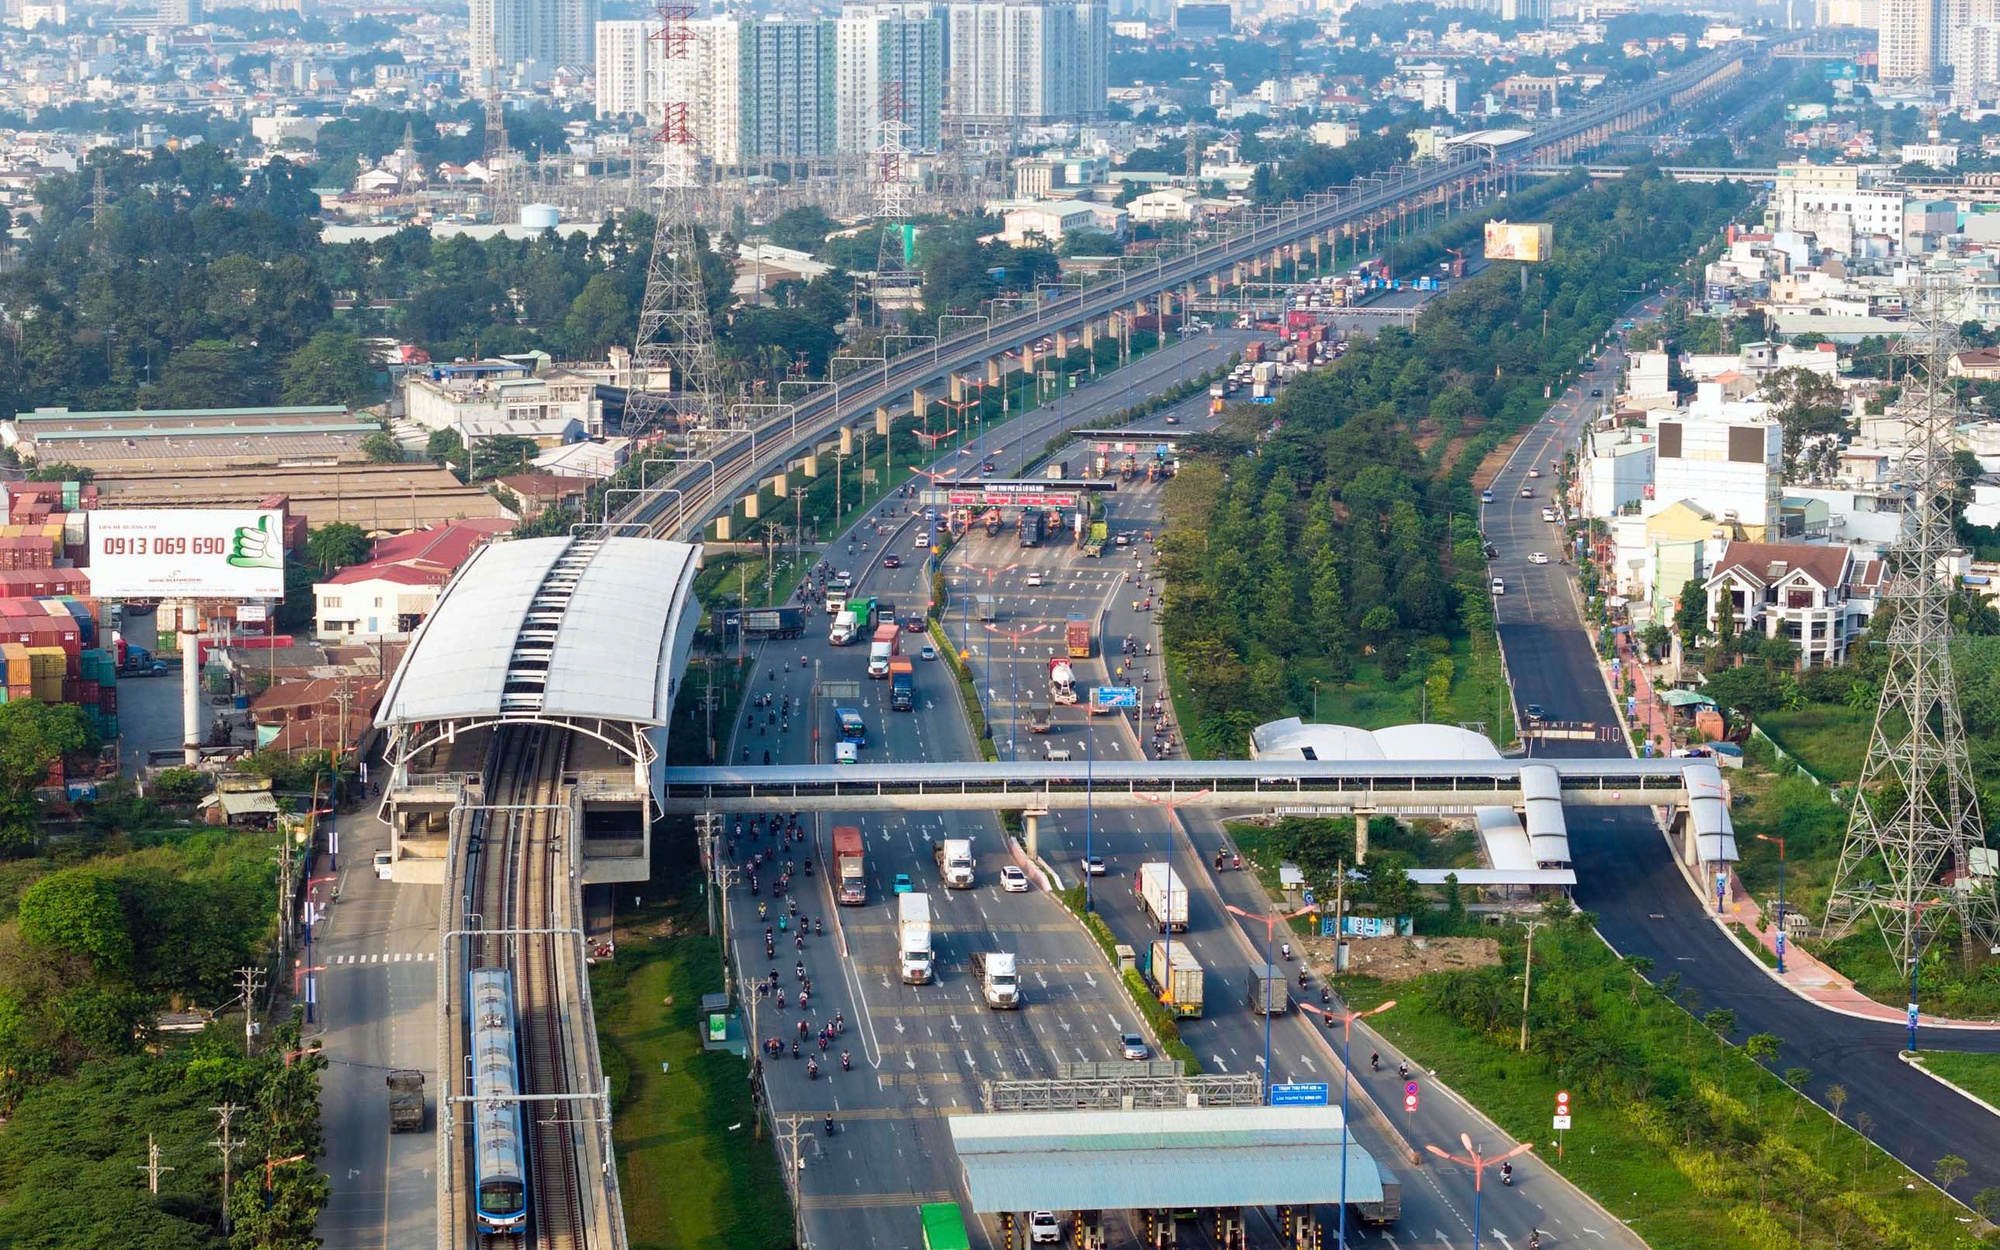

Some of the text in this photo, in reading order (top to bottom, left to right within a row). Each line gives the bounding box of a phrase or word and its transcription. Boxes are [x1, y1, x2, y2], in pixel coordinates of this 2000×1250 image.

[104, 537, 225, 555] 0913 069 690
